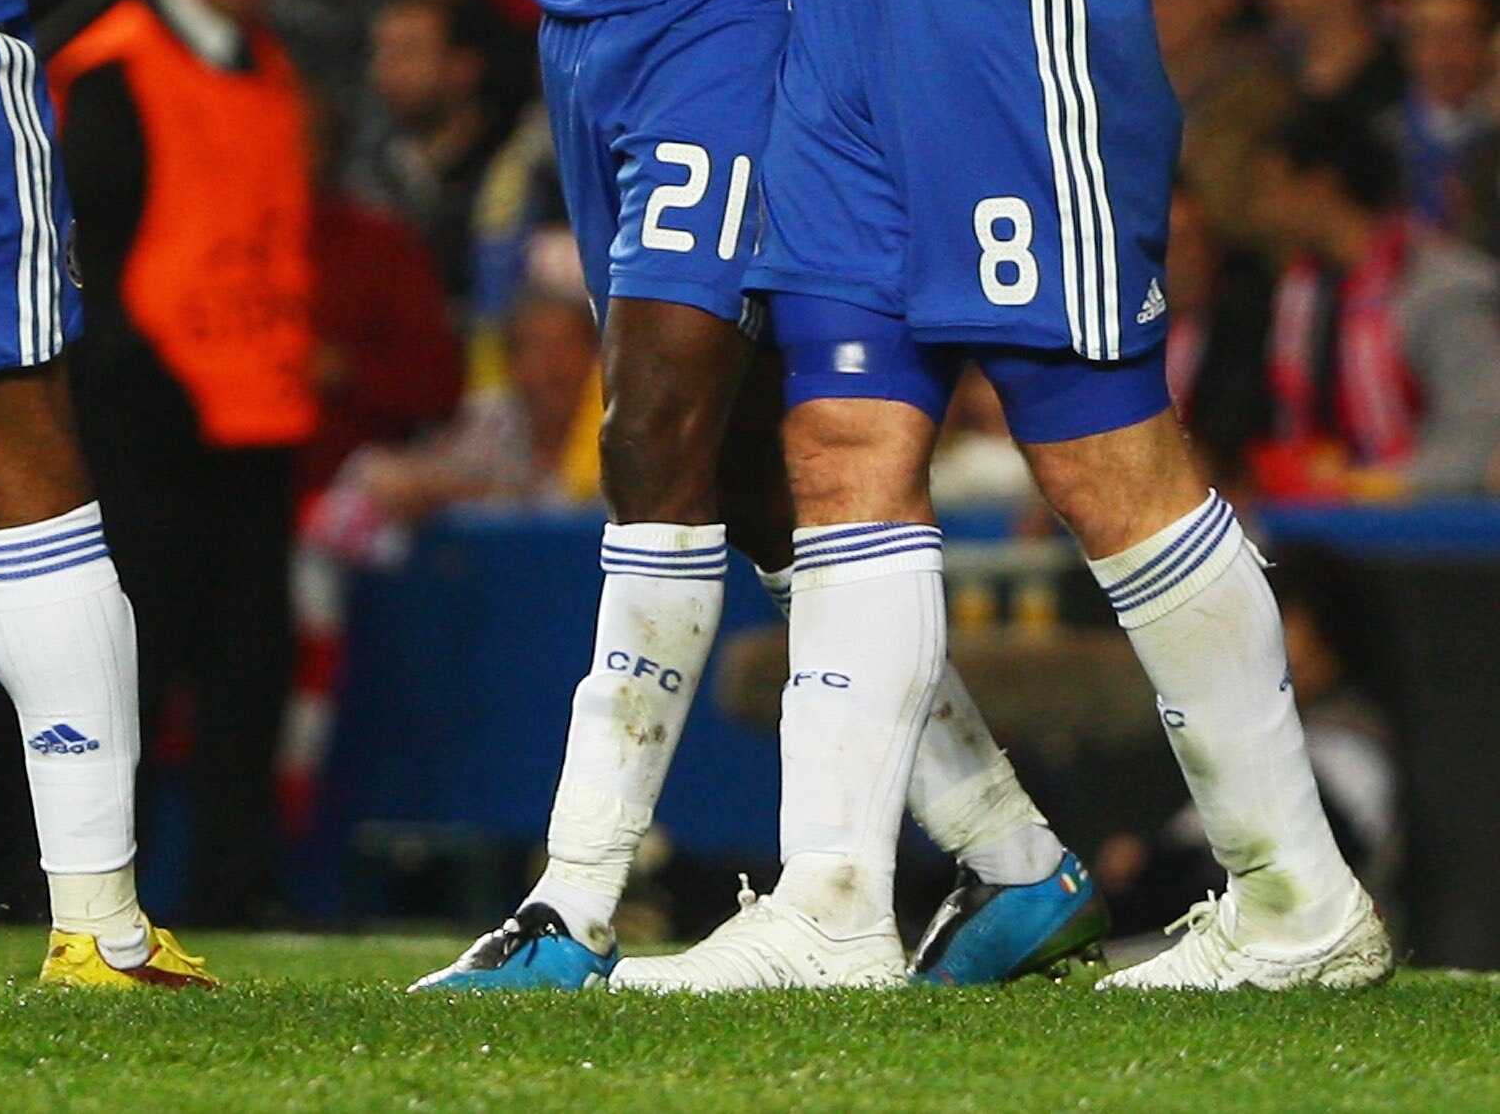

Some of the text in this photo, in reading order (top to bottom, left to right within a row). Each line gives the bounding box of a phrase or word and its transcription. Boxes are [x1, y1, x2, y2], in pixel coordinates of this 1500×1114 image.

[640, 141, 752, 261] 21
[973, 195, 1040, 306] 8
[607, 651, 683, 695] CFC
